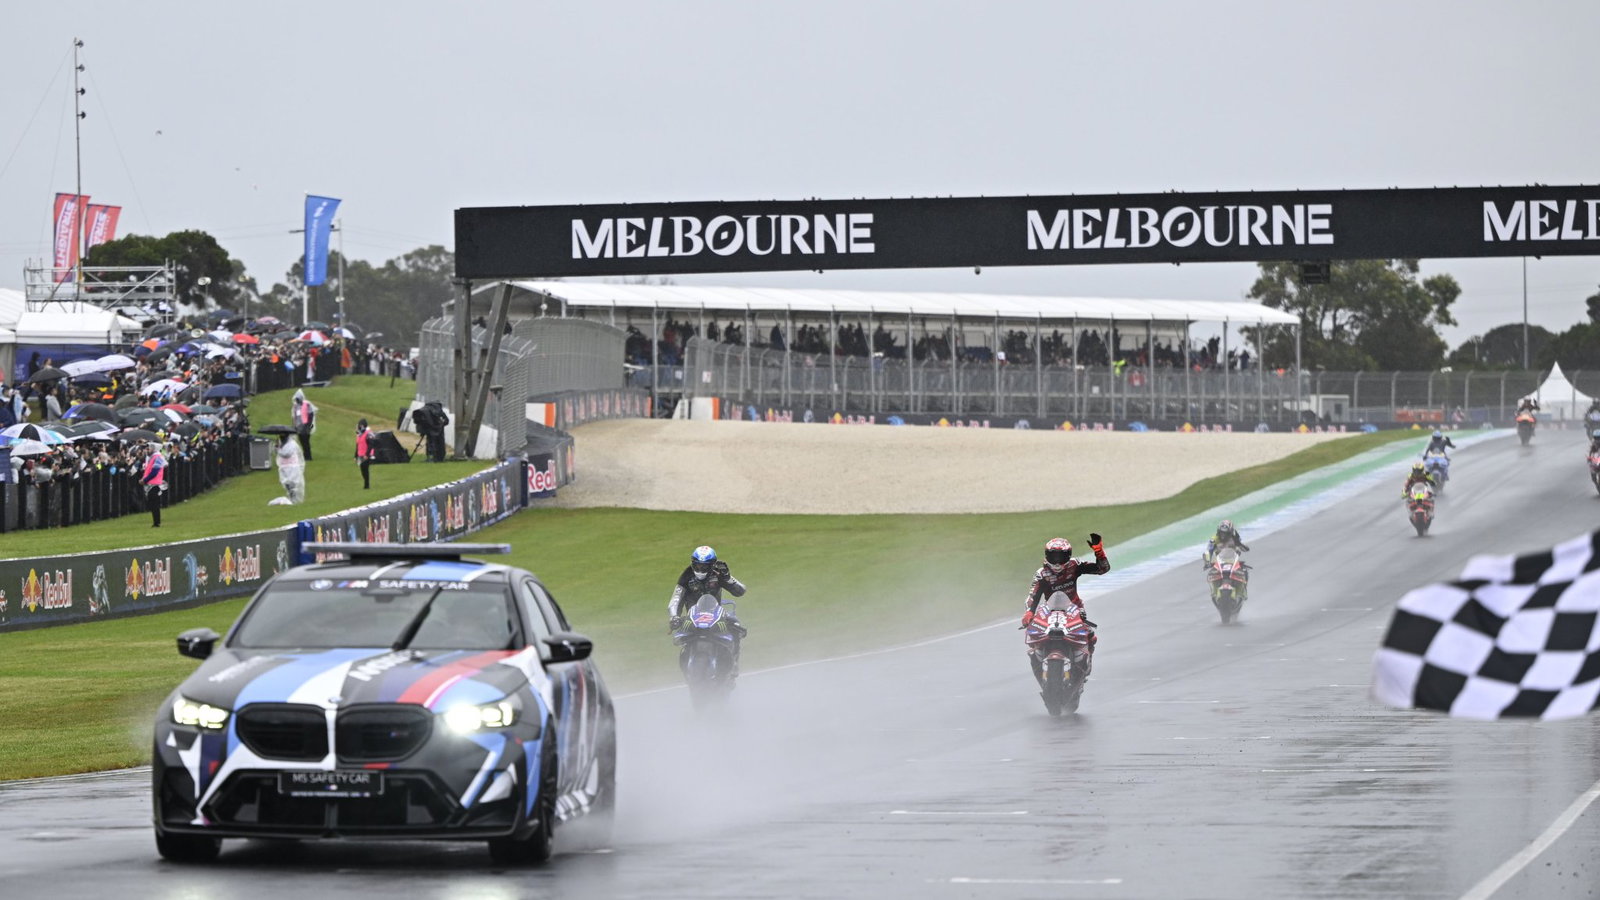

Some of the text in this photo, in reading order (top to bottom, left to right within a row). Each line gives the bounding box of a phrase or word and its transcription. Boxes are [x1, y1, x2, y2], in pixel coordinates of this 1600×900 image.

[56, 201, 75, 267] STRAIGHT
[571, 213, 876, 259] MELBOURNE
[1027, 203, 1335, 250] MELBOURNE
[379, 580, 437, 589] SAFETY
[438, 580, 470, 590] CAR
[1051, 580, 1074, 591] Lenovo
[292, 773, 371, 784] MS SAFETY CAR
